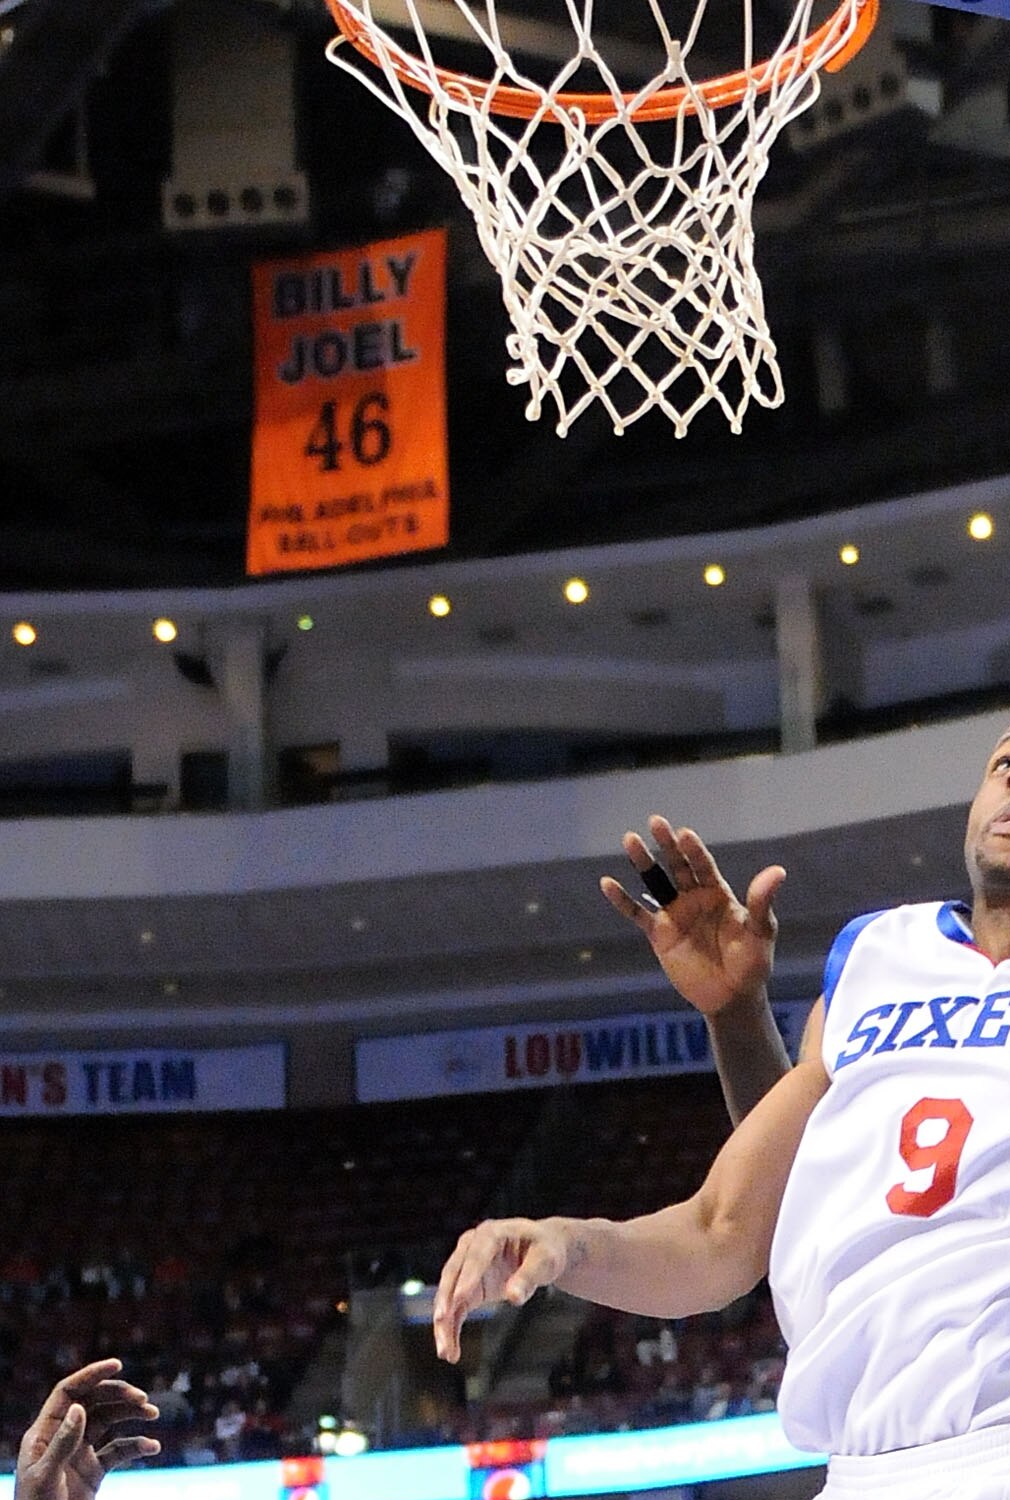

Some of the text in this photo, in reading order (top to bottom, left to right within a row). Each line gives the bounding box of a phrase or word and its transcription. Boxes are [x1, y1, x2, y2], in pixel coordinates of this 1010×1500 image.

[273, 251, 420, 321] BILLY
[277, 319, 419, 384] JOEL
[304, 391, 392, 472] 46
[82, 1060, 197, 1104] TEAM
[885, 1096, 975, 1218] 9
